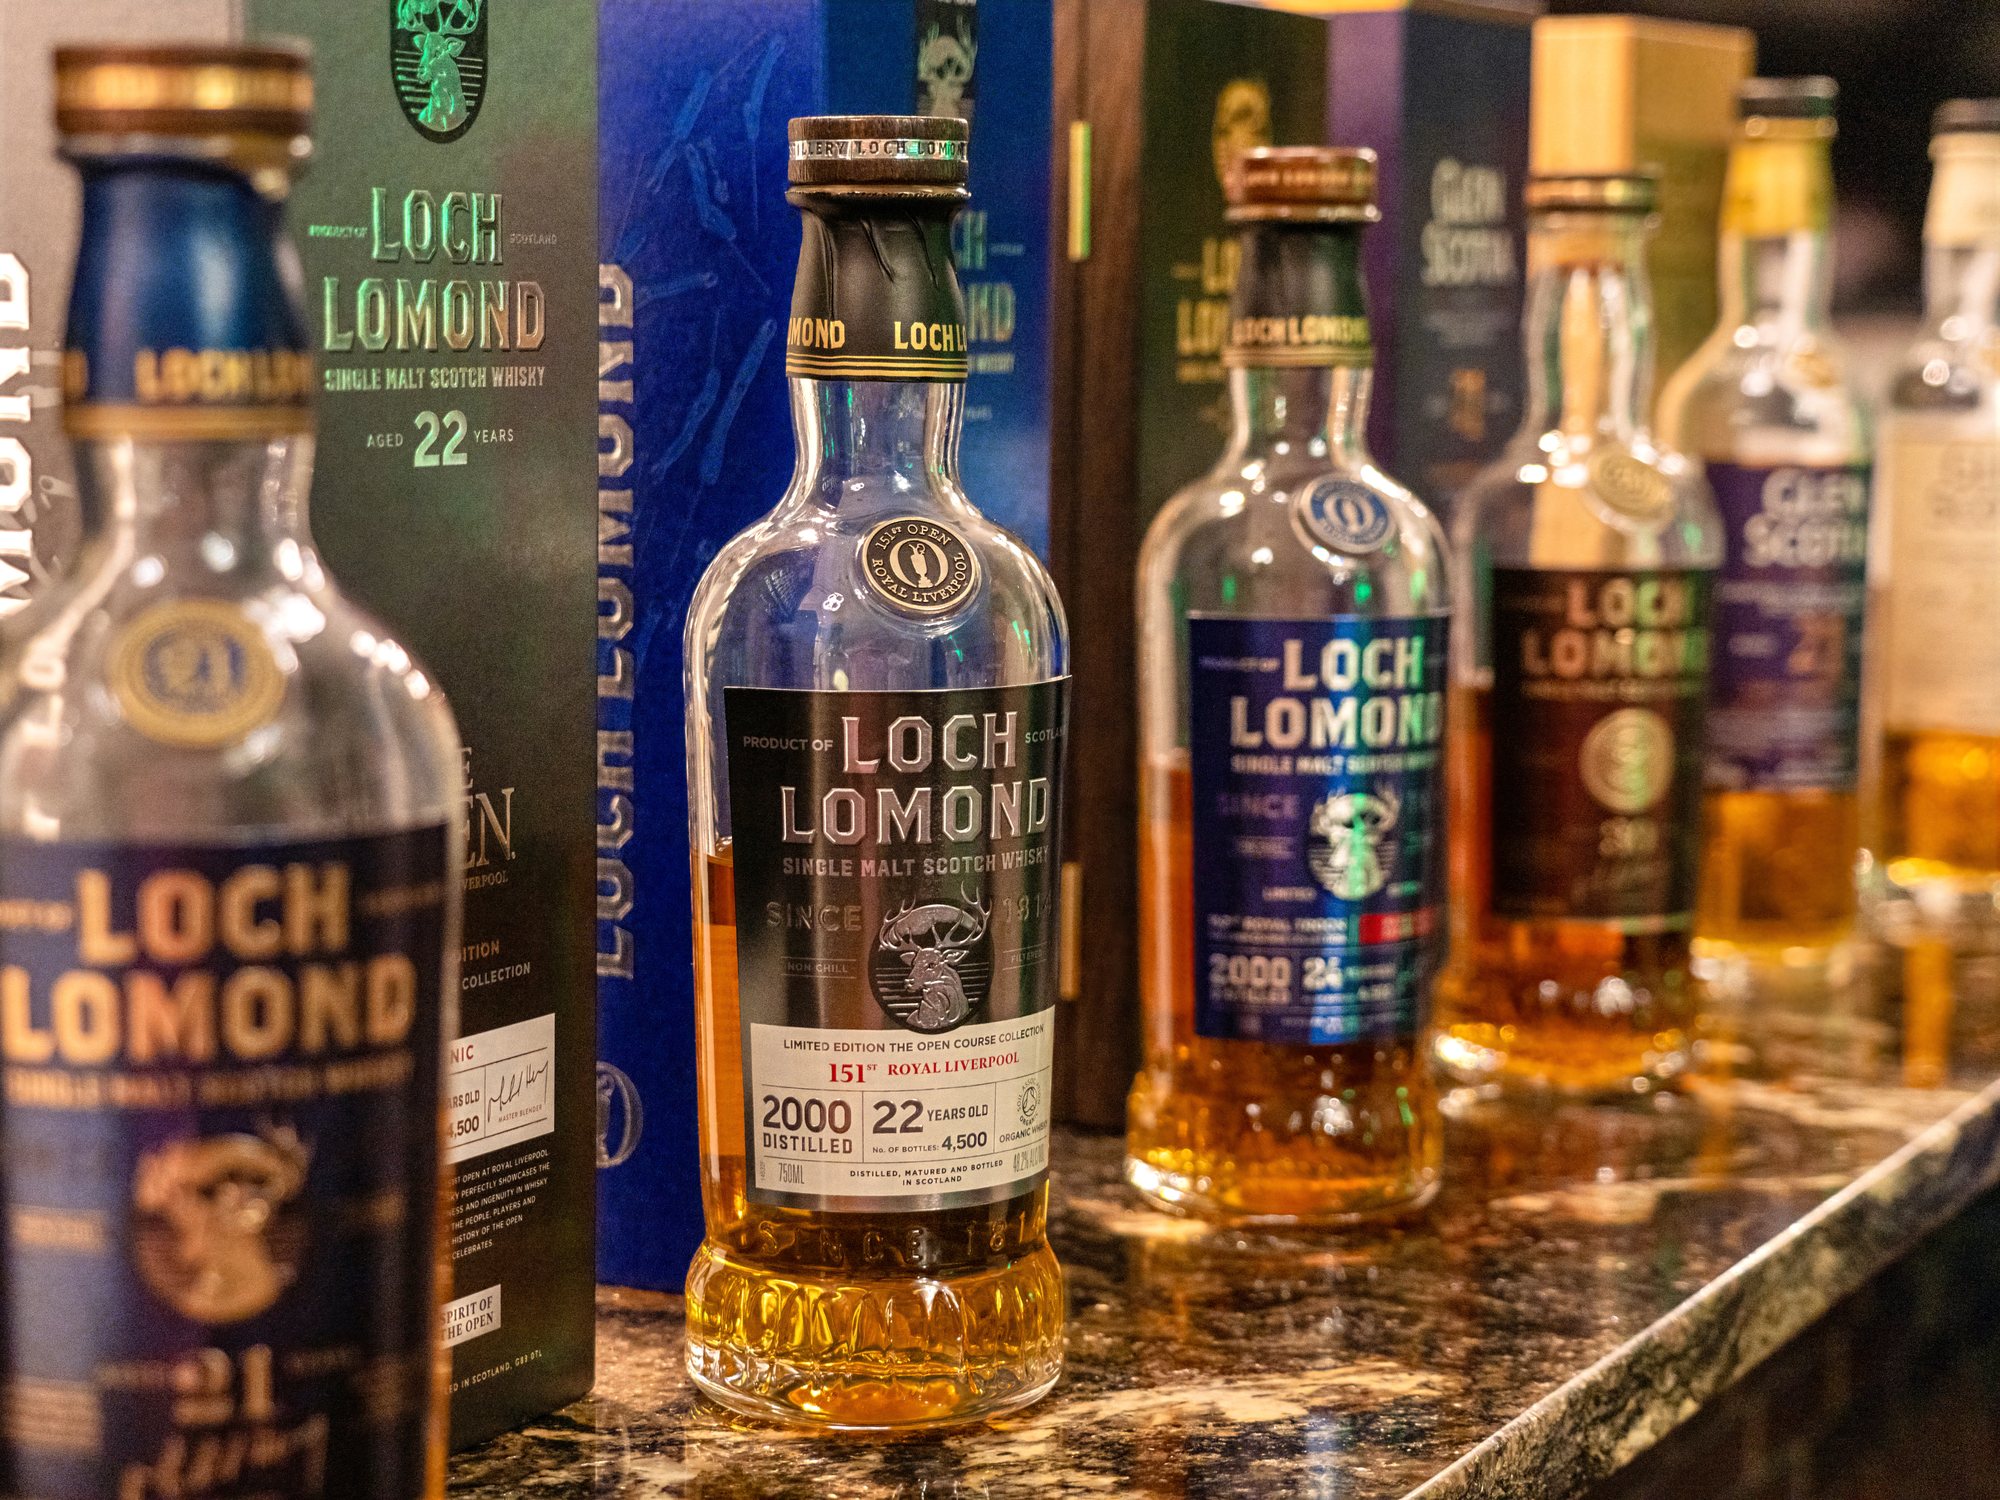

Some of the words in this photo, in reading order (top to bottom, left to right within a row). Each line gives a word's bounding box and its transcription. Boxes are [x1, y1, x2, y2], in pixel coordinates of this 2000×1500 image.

[854, 141, 907, 156] LOCH
[372, 187, 503, 265] LOCH
[324, 276, 545, 351] LOMOND
[894, 321, 953, 352] LOCH
[325, 369, 381, 391] SINGLE
[386, 368, 425, 389] MALT
[430, 367, 487, 388] SCOTCH
[491, 366, 545, 387] WHISKY
[367, 433, 403, 448] AGED
[413, 410, 468, 468] 22
[474, 428, 514, 443] YEARS
[907, 524, 951, 545] OPEN
[872, 558, 908, 598] ROYAL
[912, 552, 967, 603] LIVERPOOL
[1283, 636, 1425, 691] LOCH
[743, 736, 808, 751] PRODUCT
[812, 739, 833, 752] OF
[842, 711, 1017, 774] LOCH
[781, 777, 1050, 845] LOMOND
[783, 857, 852, 877] SINGLE
[861, 858, 915, 877] MALT
[923, 854, 996, 876] SCOTCH
[1002, 845, 1049, 870] WHISKY
[77, 860, 350, 967] LOCH
[766, 900, 862, 932] SINCE
[462, 962, 530, 990] COLLECTION
[788, 962, 811, 973] NON
[815, 962, 849, 974] CHILL
[0, 953, 418, 1065] LOMOND
[784, 1039, 830, 1052] LIMITED
[833, 1042, 885, 1053] EDITION
[889, 1043, 914, 1053] THE
[917, 1039, 950, 1052] OPEN
[954, 1034, 996, 1050] COURSE
[999, 1023, 1045, 1044] COLLECTION
[829, 1063, 877, 1083] 151ST
[888, 1062, 941, 1076] ROYAL
[945, 1052, 1020, 1073] LIVERPOOL
[465, 1090, 480, 1104] OLD
[519, 1104, 543, 1118] BLENDER
[763, 1095, 851, 1134] 2000
[872, 1100, 923, 1134] 22
[927, 1108, 966, 1122] YEARS
[968, 1104, 989, 1118] OLD
[763, 1135, 852, 1154] DISTILLED
[888, 1145, 900, 1153] OF
[902, 1144, 940, 1153] BOTTLES:
[941, 1131, 987, 1151] 4,500
[999, 1127, 1031, 1143] ORGANIC
[461, 1180, 497, 1198] PERFECTLY
[498, 1167, 537, 1186] SHOWCASES
[538, 1162, 551, 1173] THE
[462, 1171, 480, 1183] OPEN
[482, 1167, 490, 1177] AT
[492, 1161, 512, 1174] ROYAL
[515, 1149, 549, 1166] LIVERPOOL
[778, 1163, 804, 1185] 750ML
[850, 1168, 901, 1179] DISTILLED,
[904, 1167, 947, 1177] MATURED
[950, 1165, 968, 1175] AND
[971, 1159, 1003, 1171] BOTTLED
[902, 1179, 912, 1187] IN
[915, 1176, 962, 1187] SCOTLAND
[465, 1200, 480, 1211] AND
[481, 1188, 515, 1206] INGENUITY
[516, 1185, 523, 1194] IN
[524, 1177, 548, 1192] WHISKY
[451, 1219, 464, 1231] THE
[493, 1200, 521, 1216] PLAYERS
[522, 1195, 536, 1206] AND
[452, 1230, 480, 1245] HISTORY
[481, 1225, 490, 1235] OF
[492, 1220, 504, 1231] THE
[505, 1214, 523, 1226] OPEN
[480, 1296, 493, 1312] OF
[465, 1311, 494, 1333] OPEN
[461, 1378, 469, 1388] IN
